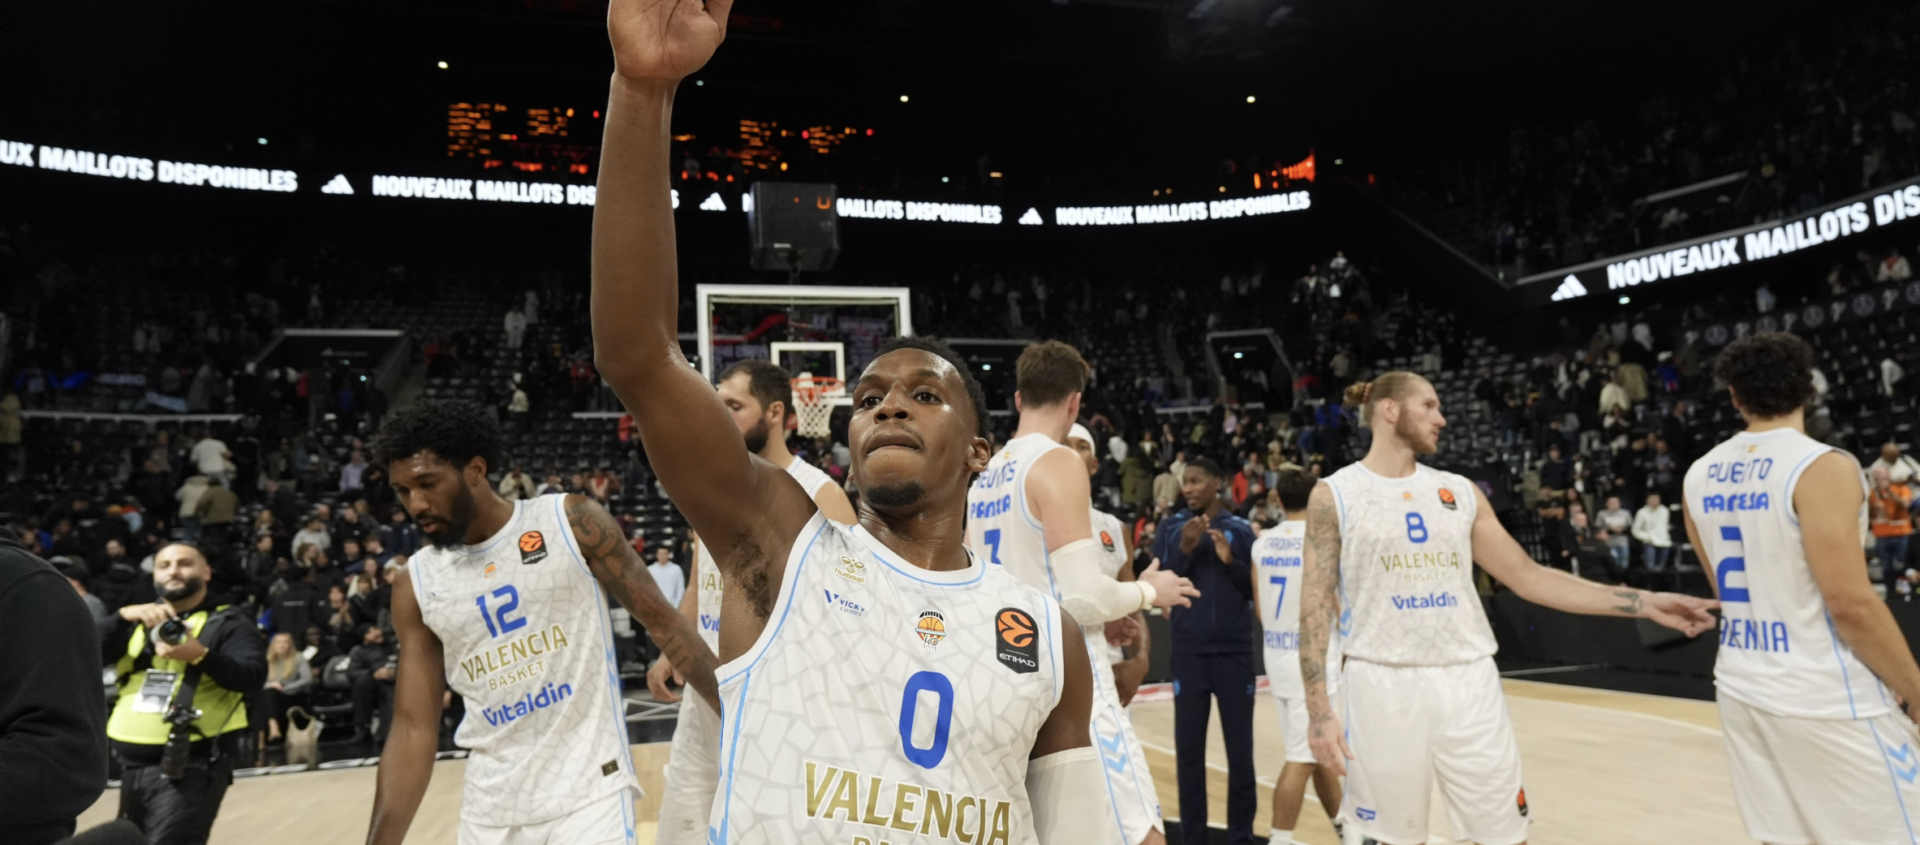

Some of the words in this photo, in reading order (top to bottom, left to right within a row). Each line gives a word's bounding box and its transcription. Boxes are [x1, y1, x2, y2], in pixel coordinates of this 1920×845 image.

[39, 145, 154, 181] MAILLOTS
[158, 160, 298, 192] DISPONIBLES
[372, 175, 473, 199] NOUVEAUX
[476, 180, 564, 204] MAILLOTS
[1055, 206, 1134, 225] NOUVEAUX
[1135, 202, 1209, 223] MAILLOTS
[1209, 190, 1311, 219] DISPONIBLES
[906, 201, 1003, 224] DISPONIBLES
[1606, 237, 1741, 290] NOUVEAUX
[1744, 202, 1869, 262] MAILLOTS
[1405, 511, 1428, 544] 8
[1379, 551, 1460, 573] VALENCIA
[1717, 526, 1750, 603] 2
[476, 584, 528, 639] 12
[839, 606, 862, 617] FOODS
[840, 599, 866, 613] VICKY
[1270, 575, 1288, 621] 7
[460, 624, 570, 684] VALENCIA
[999, 652, 1037, 668] ETIHAD
[488, 660, 546, 691] BASKET
[482, 682, 573, 727] Vitaldin
[899, 670, 955, 770] 0
[804, 760, 1011, 845] VALENCIA
